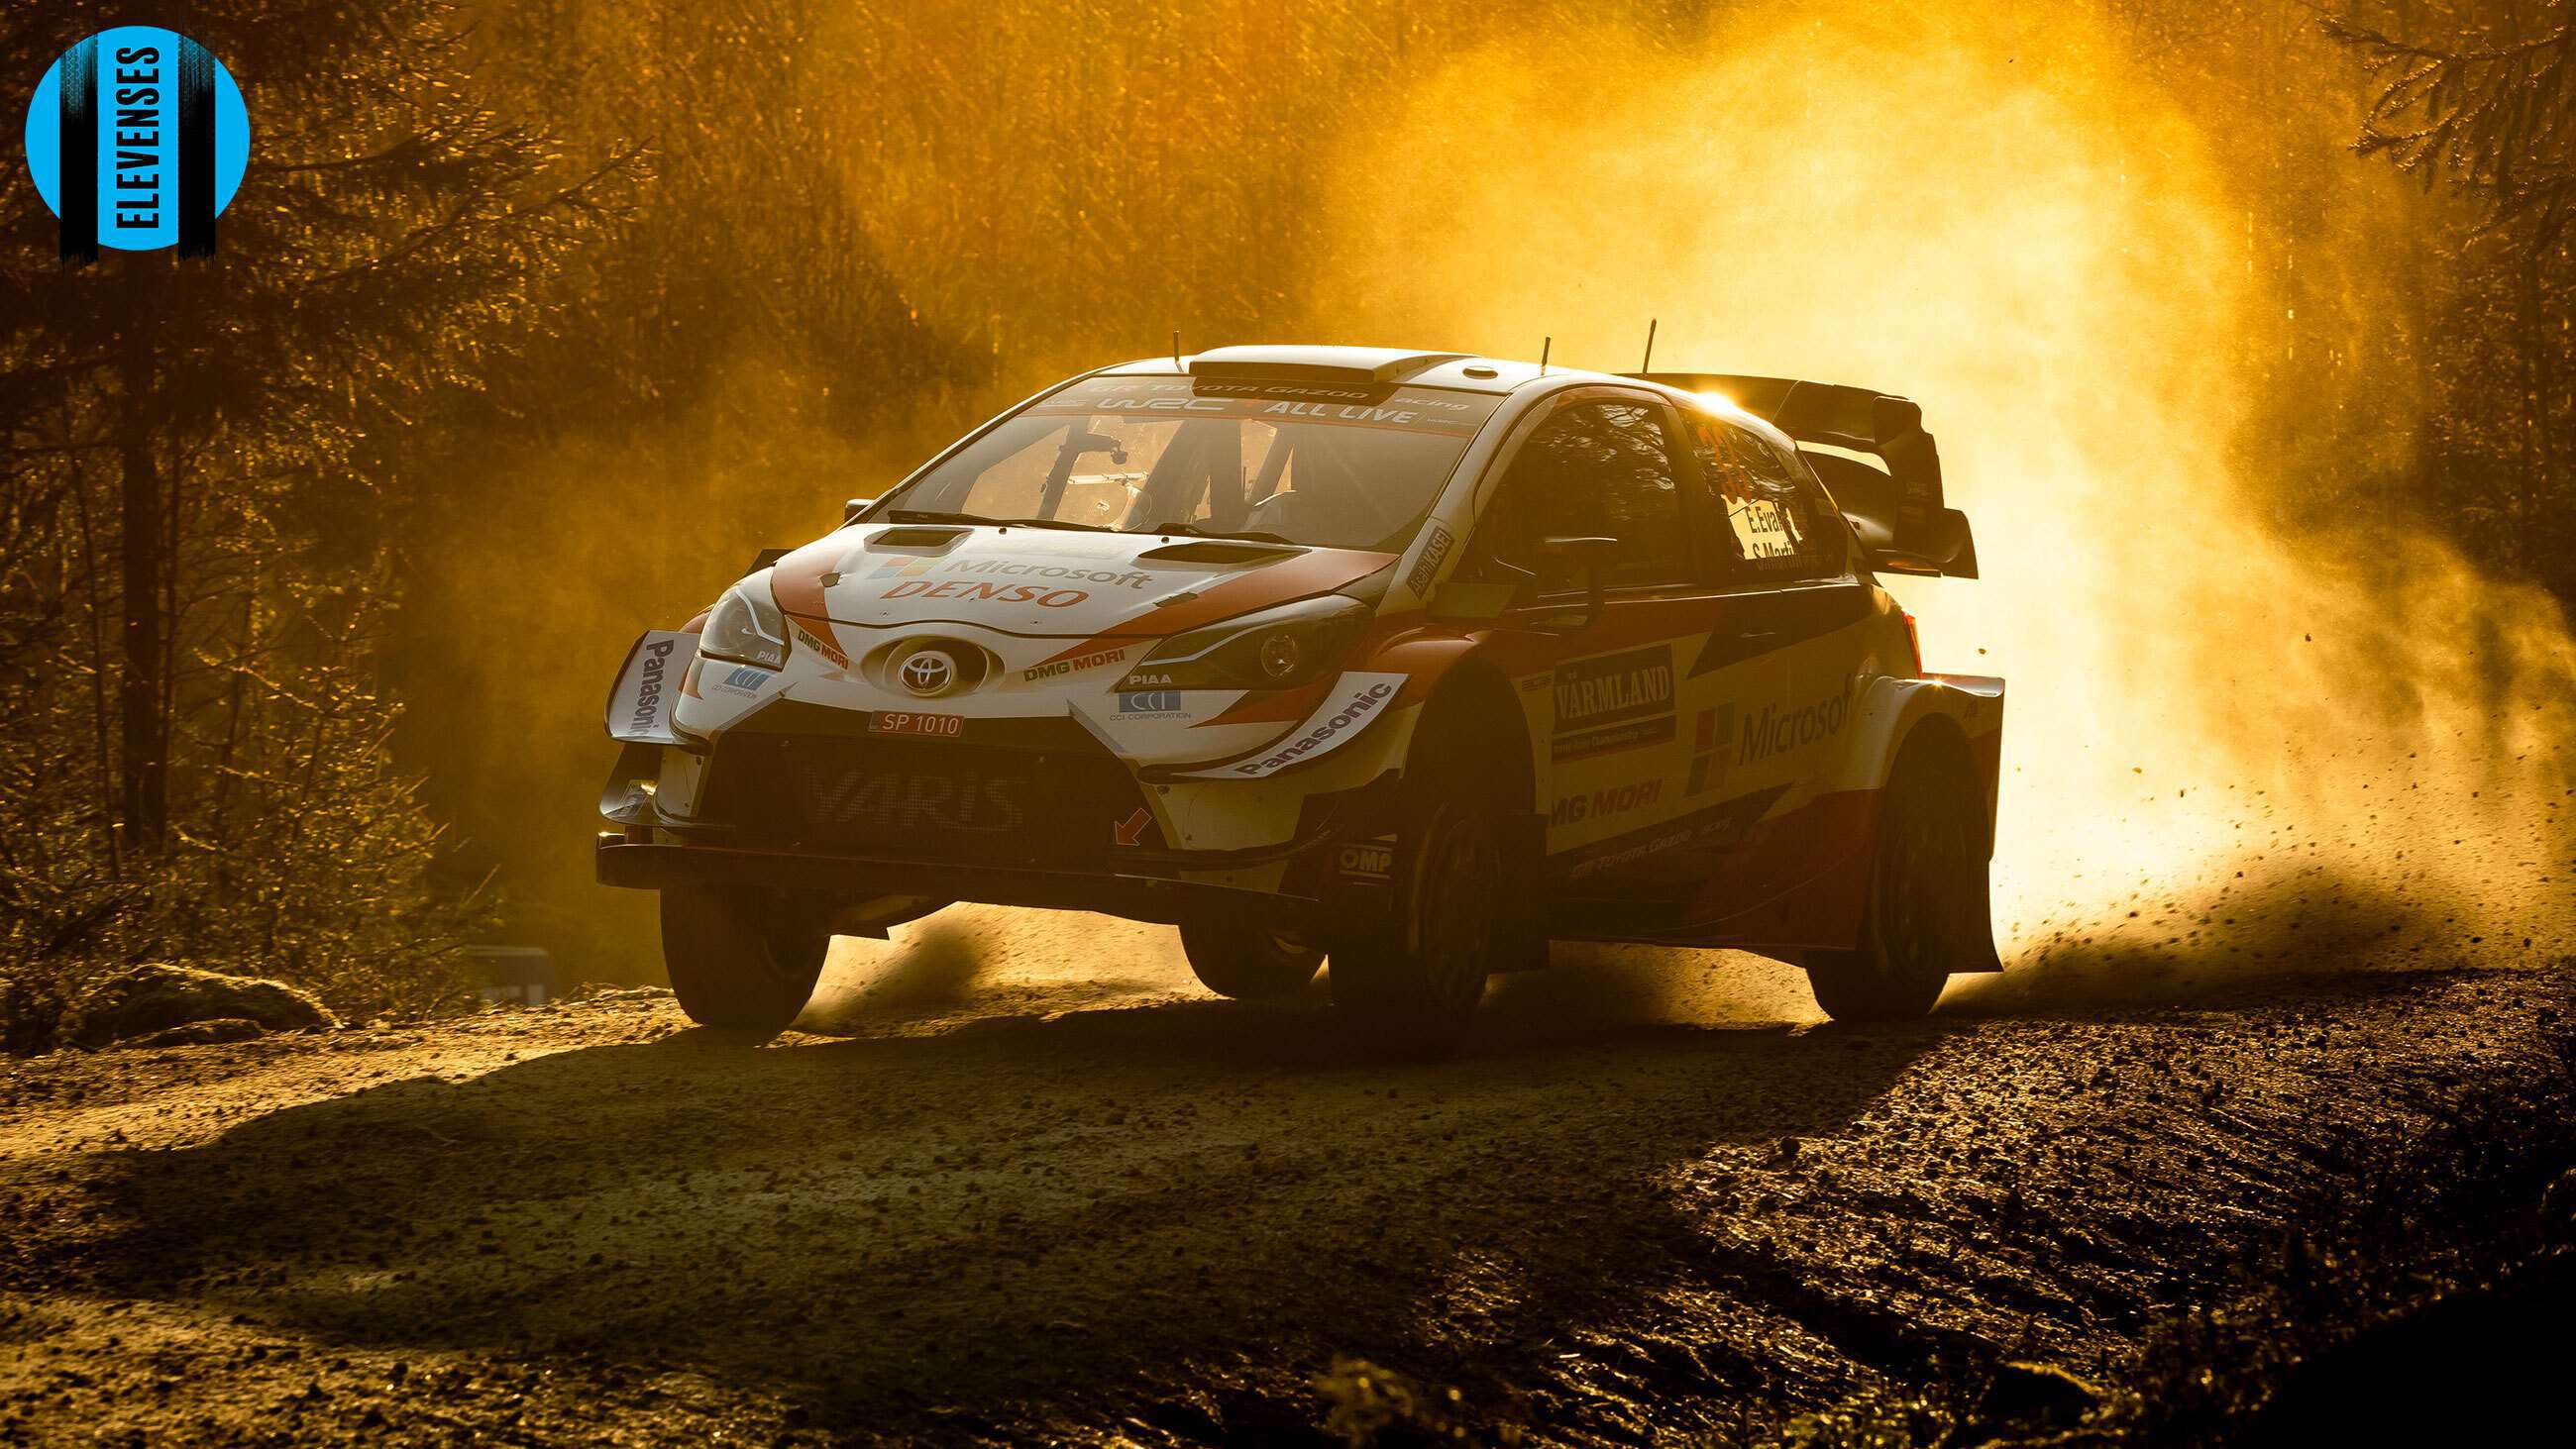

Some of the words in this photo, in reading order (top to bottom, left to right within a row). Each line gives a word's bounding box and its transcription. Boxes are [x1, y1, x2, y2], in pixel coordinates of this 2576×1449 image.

[1267, 386, 1369, 399] GAZOO
[1096, 397, 1236, 411] WRC
[1263, 401, 1328, 417] ALL
[1340, 405, 1421, 425] LIVE
[944, 559, 1157, 589] Microsoft
[879, 580, 1090, 608] DENSO
[756, 650, 783, 665] PIAA
[797, 629, 821, 653] DMG
[820, 644, 849, 671] MORI
[1023, 661, 1071, 682] DMG
[1073, 650, 1126, 672] MORI
[1128, 674, 1173, 685] PIAA
[1130, 691, 1167, 710] CCI
[1556, 665, 1670, 720] VÄRMLAND
[883, 714, 910, 732] SP
[916, 715, 959, 735] 1010
[1127, 712, 1191, 721] CORPORATION
[1234, 679, 1393, 777] Panasonic
[801, 768, 1031, 832] YARIS
[1339, 848, 1393, 873] OMP
